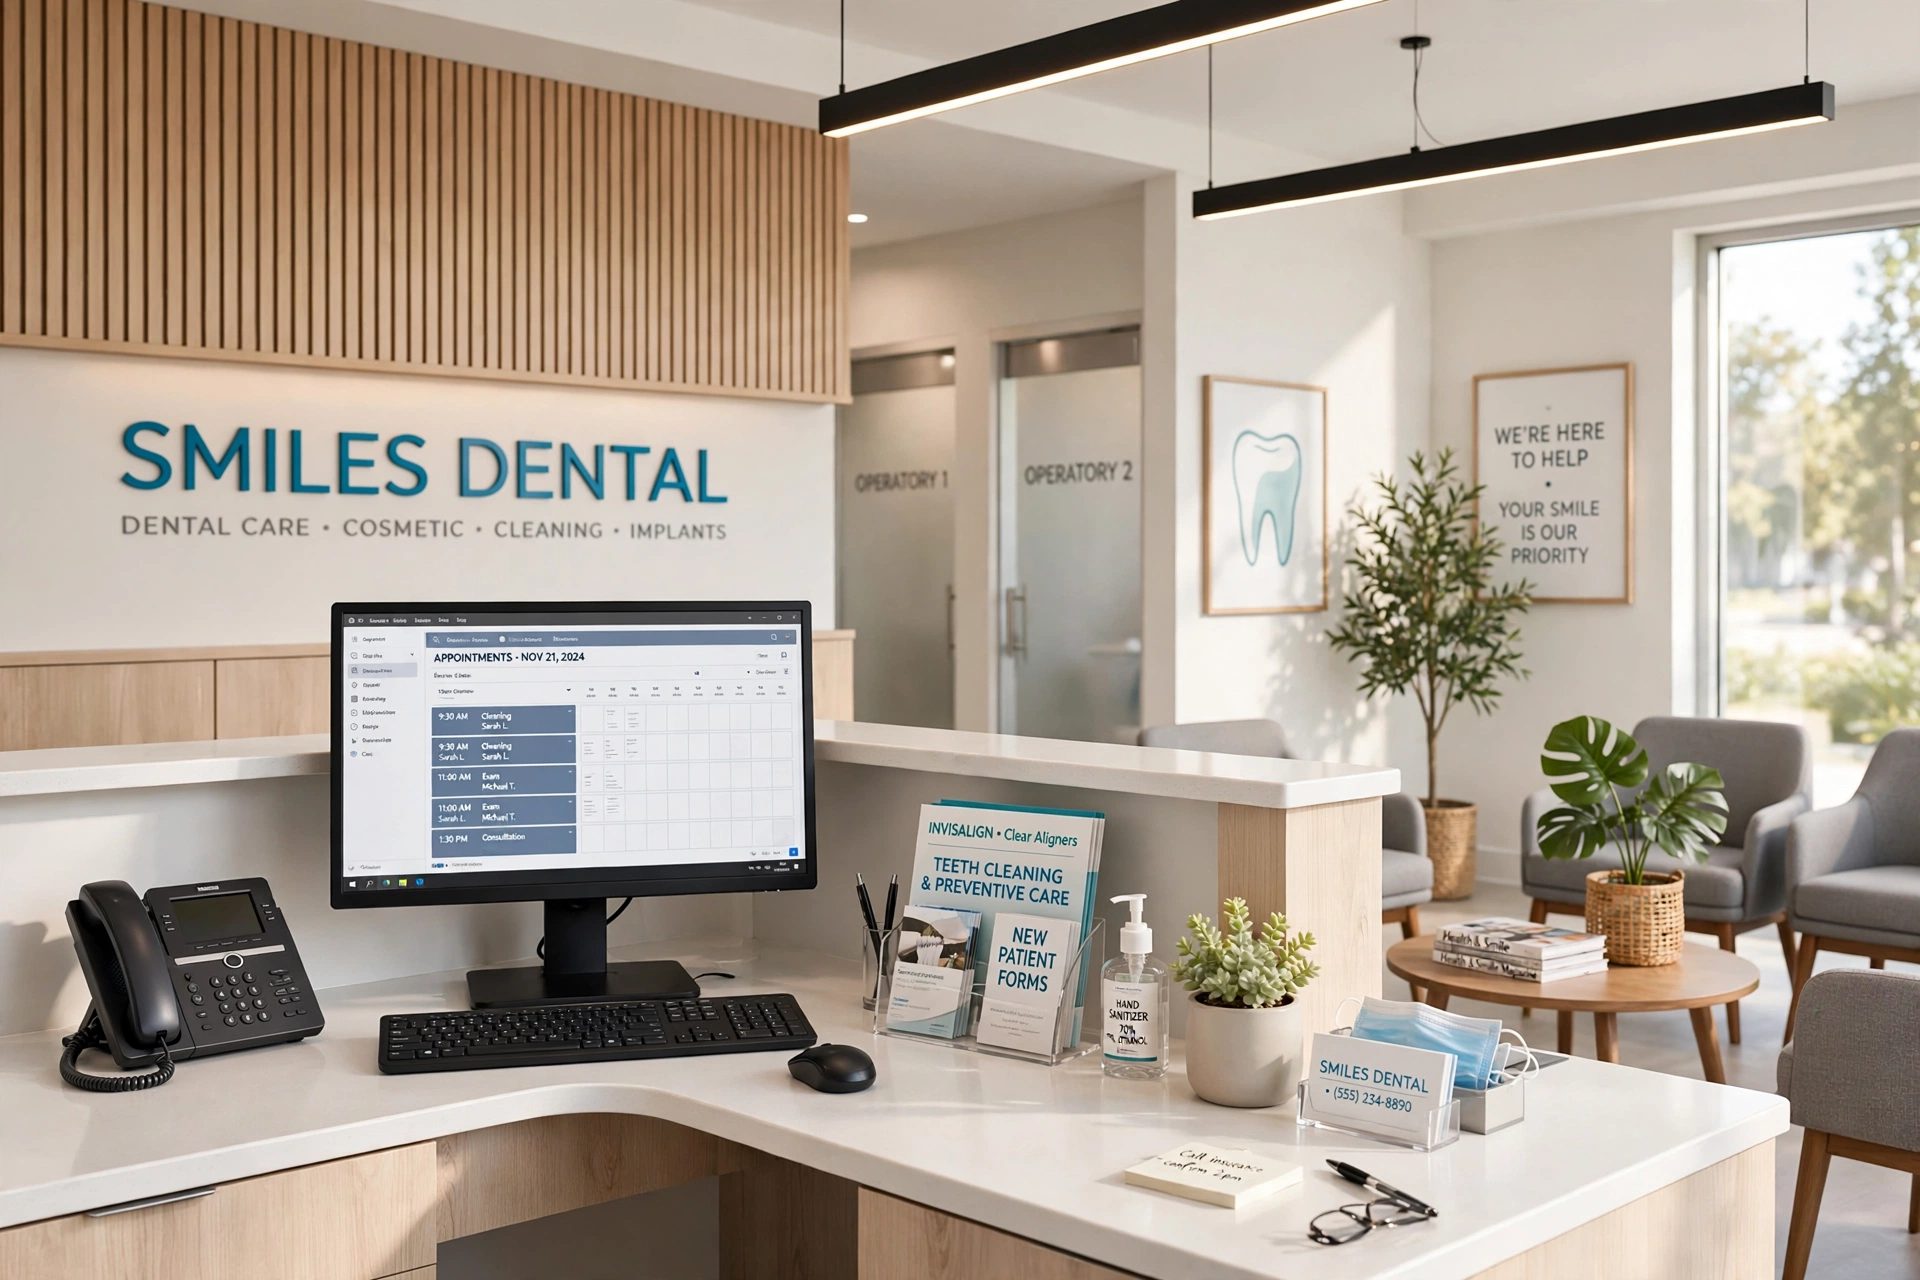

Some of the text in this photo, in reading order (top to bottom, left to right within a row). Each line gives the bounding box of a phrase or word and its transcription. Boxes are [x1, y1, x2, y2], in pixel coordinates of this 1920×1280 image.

[1494, 421, 1605, 445] WE'RE HERE
[120, 420, 728, 503] SMILES DENTAL
[1511, 448, 1588, 469] TO HELP
[855, 470, 948, 493] OPERATORY 1
[1024, 460, 1133, 485] OPERATORY 2
[1499, 500, 1600, 518] YOUR SMILE
[121, 515, 727, 541] DENTAL CARE COSMETIC CLEANING IMPLANTS
[1521, 523, 1577, 541] IS OUR
[1511, 546, 1588, 564] PRIORITY
[433, 651, 585, 665] APPOINTMENTS NOV 21, 2024
[928, 821, 1078, 848] INVISALIGN Clear Aligners
[933, 856, 1063, 884] TEETH CLEANING
[921, 875, 1070, 906] & PREVENTIVE CARE
[1012, 926, 1048, 946] NEW
[998, 946, 1057, 969] PATIENT
[997, 969, 1048, 992] FORMS
[1116, 999, 1140, 1009] HAND
[1319, 1059, 1429, 1094] SMILES DENTAL
[1333, 1086, 1412, 1113] (555) 234-8890
[1179, 1150, 1207, 1160] Call
